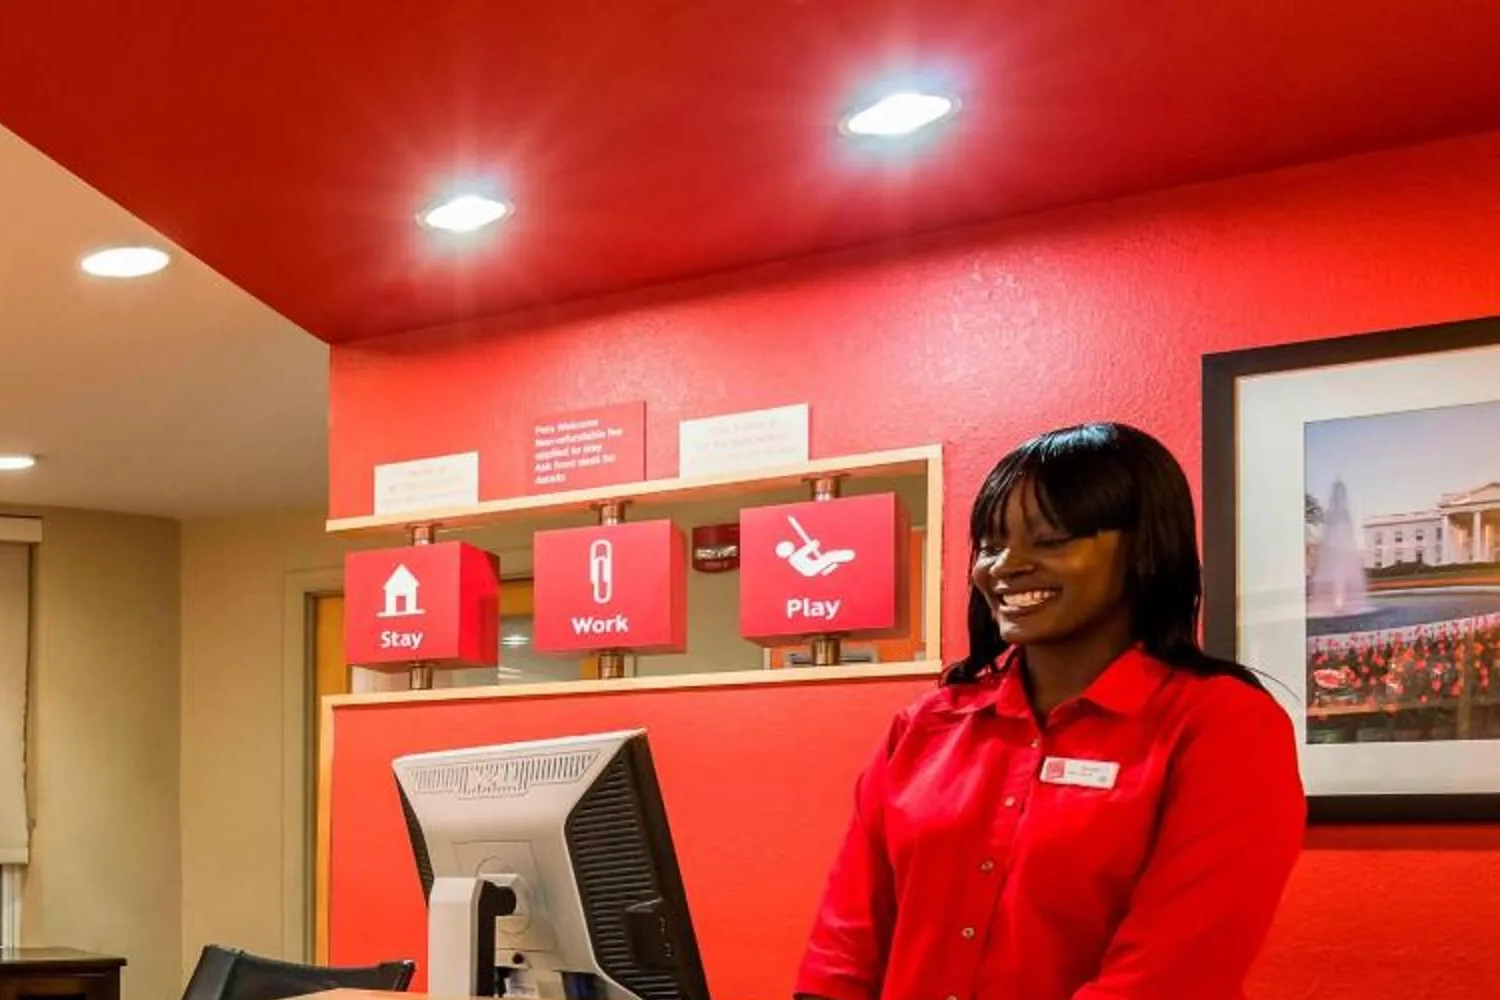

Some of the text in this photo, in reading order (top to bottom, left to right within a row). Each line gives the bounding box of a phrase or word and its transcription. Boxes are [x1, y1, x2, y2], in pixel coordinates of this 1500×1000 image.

[556, 419, 599, 432] Welcome
[786, 599, 840, 620] Play
[571, 614, 629, 635] Work
[380, 629, 423, 650] Stay
